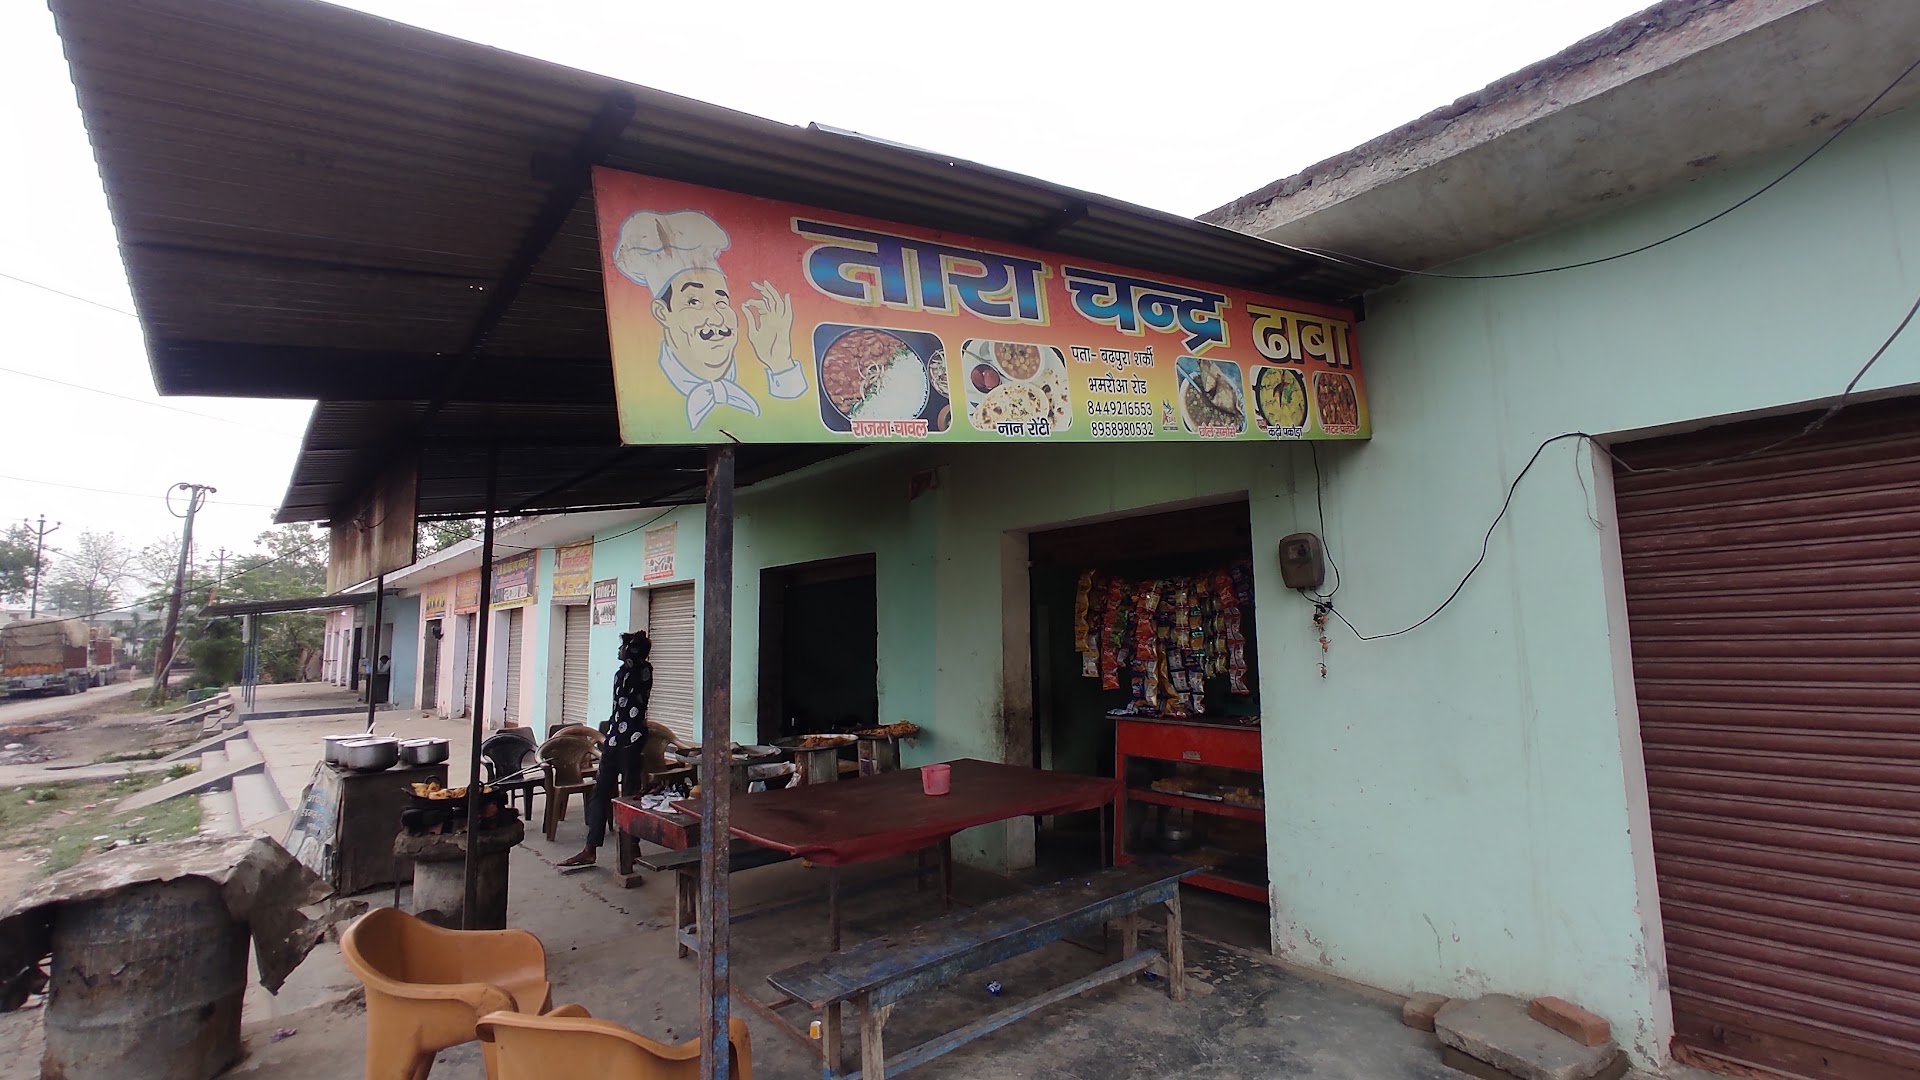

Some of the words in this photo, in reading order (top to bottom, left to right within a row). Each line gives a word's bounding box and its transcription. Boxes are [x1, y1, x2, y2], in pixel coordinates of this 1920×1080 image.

[793, 218, 1051, 325] तारा
[1064, 266, 1230, 353] चन्द्र
[1247, 303, 1350, 366] ढाबा
[1100, 349, 1131, 371] बढ़पुरा
[1088, 372, 1128, 393] भमरौआ
[1131, 374, 1147, 394] रोड
[1087, 400, 1153, 416] 8449216553
[851, 420, 891, 436] राजमा
[894, 420, 928, 437] चावल
[997, 422, 1025, 435] नान
[1027, 416, 1050, 436] रोटी
[1091, 421, 1154, 437] 8958980532
